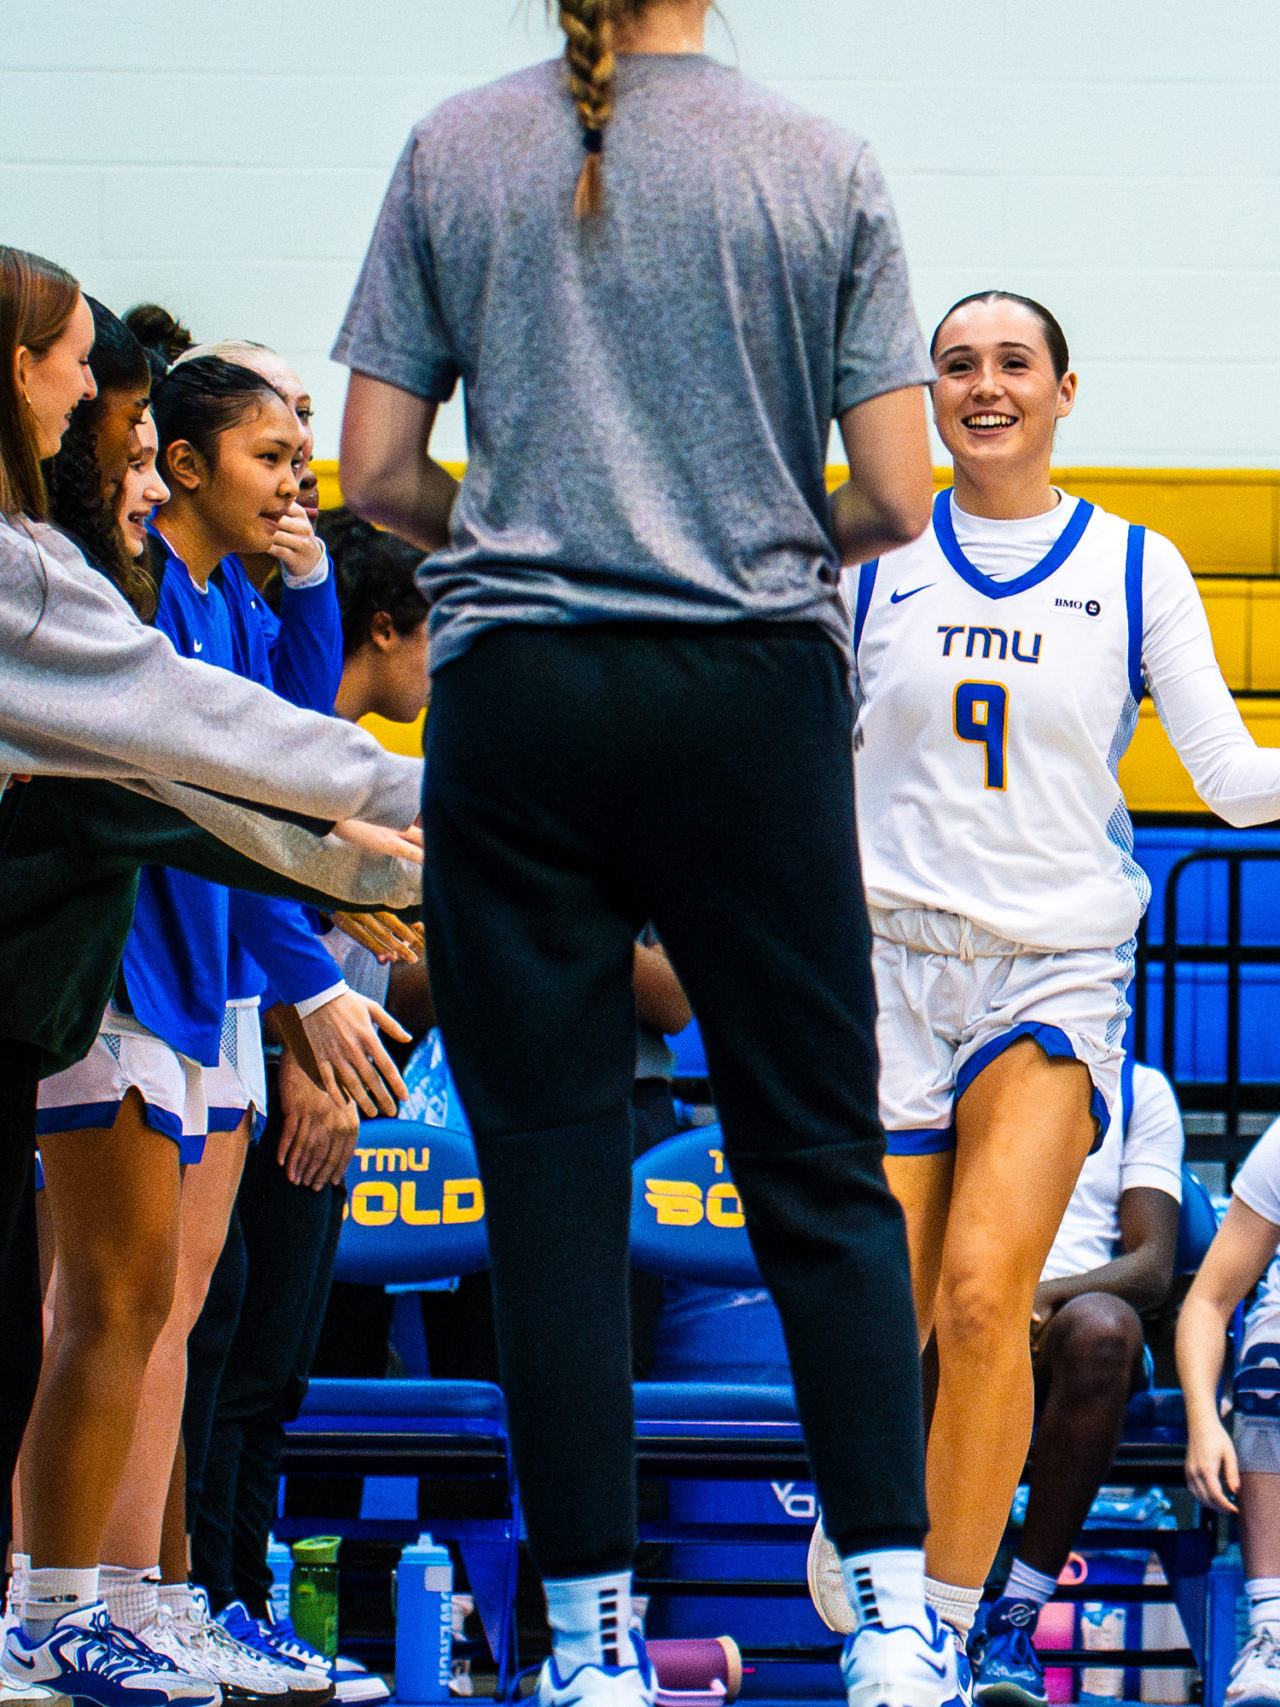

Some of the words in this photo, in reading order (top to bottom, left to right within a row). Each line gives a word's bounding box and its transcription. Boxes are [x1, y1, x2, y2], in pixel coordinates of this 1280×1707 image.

[1054, 597, 1083, 610] BMO
[937, 624, 1043, 665] TMU
[952, 678, 1010, 792] 9
[354, 1147, 430, 1173] TMU
[343, 1178, 486, 1227] OLD
[644, 1178, 746, 1229] BO
